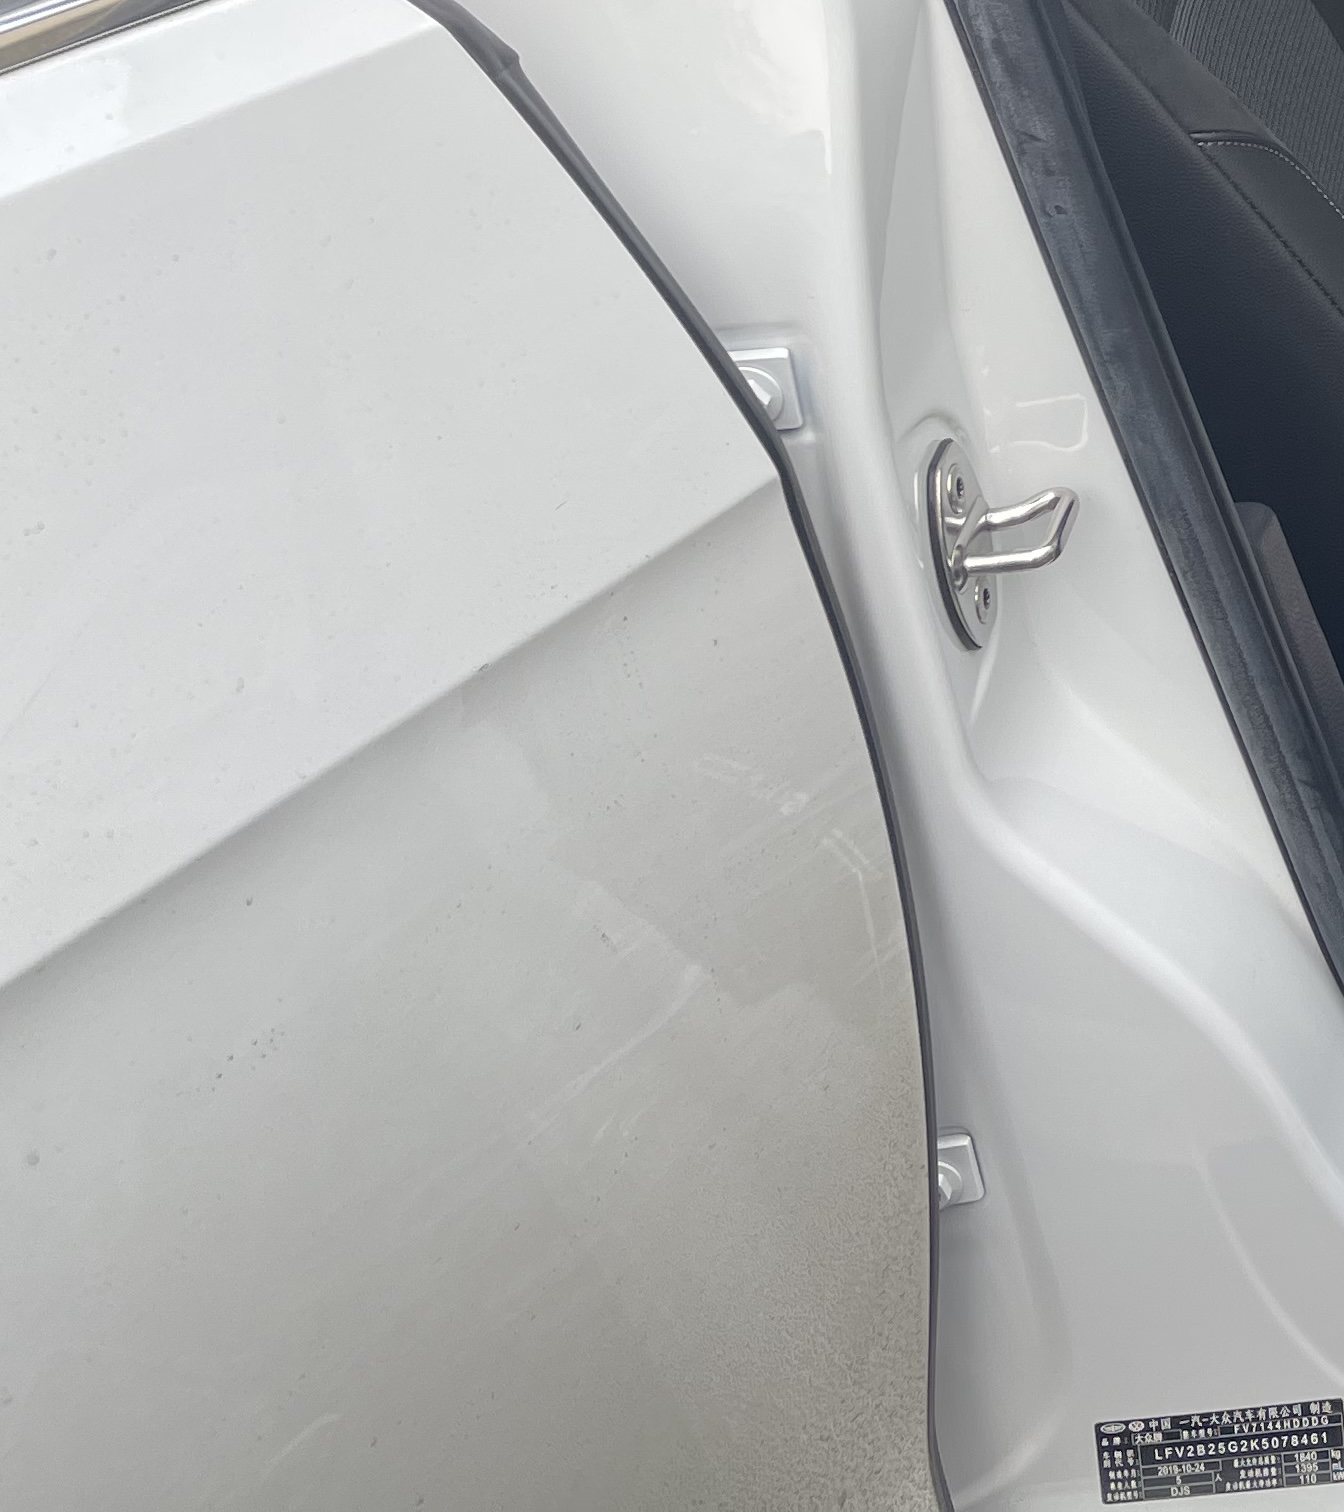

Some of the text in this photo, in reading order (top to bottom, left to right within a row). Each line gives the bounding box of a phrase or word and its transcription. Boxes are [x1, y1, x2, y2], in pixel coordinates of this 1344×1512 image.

[1149, 1401, 1333, 1431] 中国 一汽-大众汽车有限公司 制造
[1234, 1415, 1329, 1434] FV7144HDDDG
[1154, 1431, 1328, 1461] LFV2B25G2K5078461
[1331, 1449, 1341, 1460] kg
[1295, 1462, 1319, 1473] 1395
[1215, 1473, 1223, 1482] 人
[1299, 1474, 1317, 1485] 110
[1170, 1486, 1191, 1497] DJS
